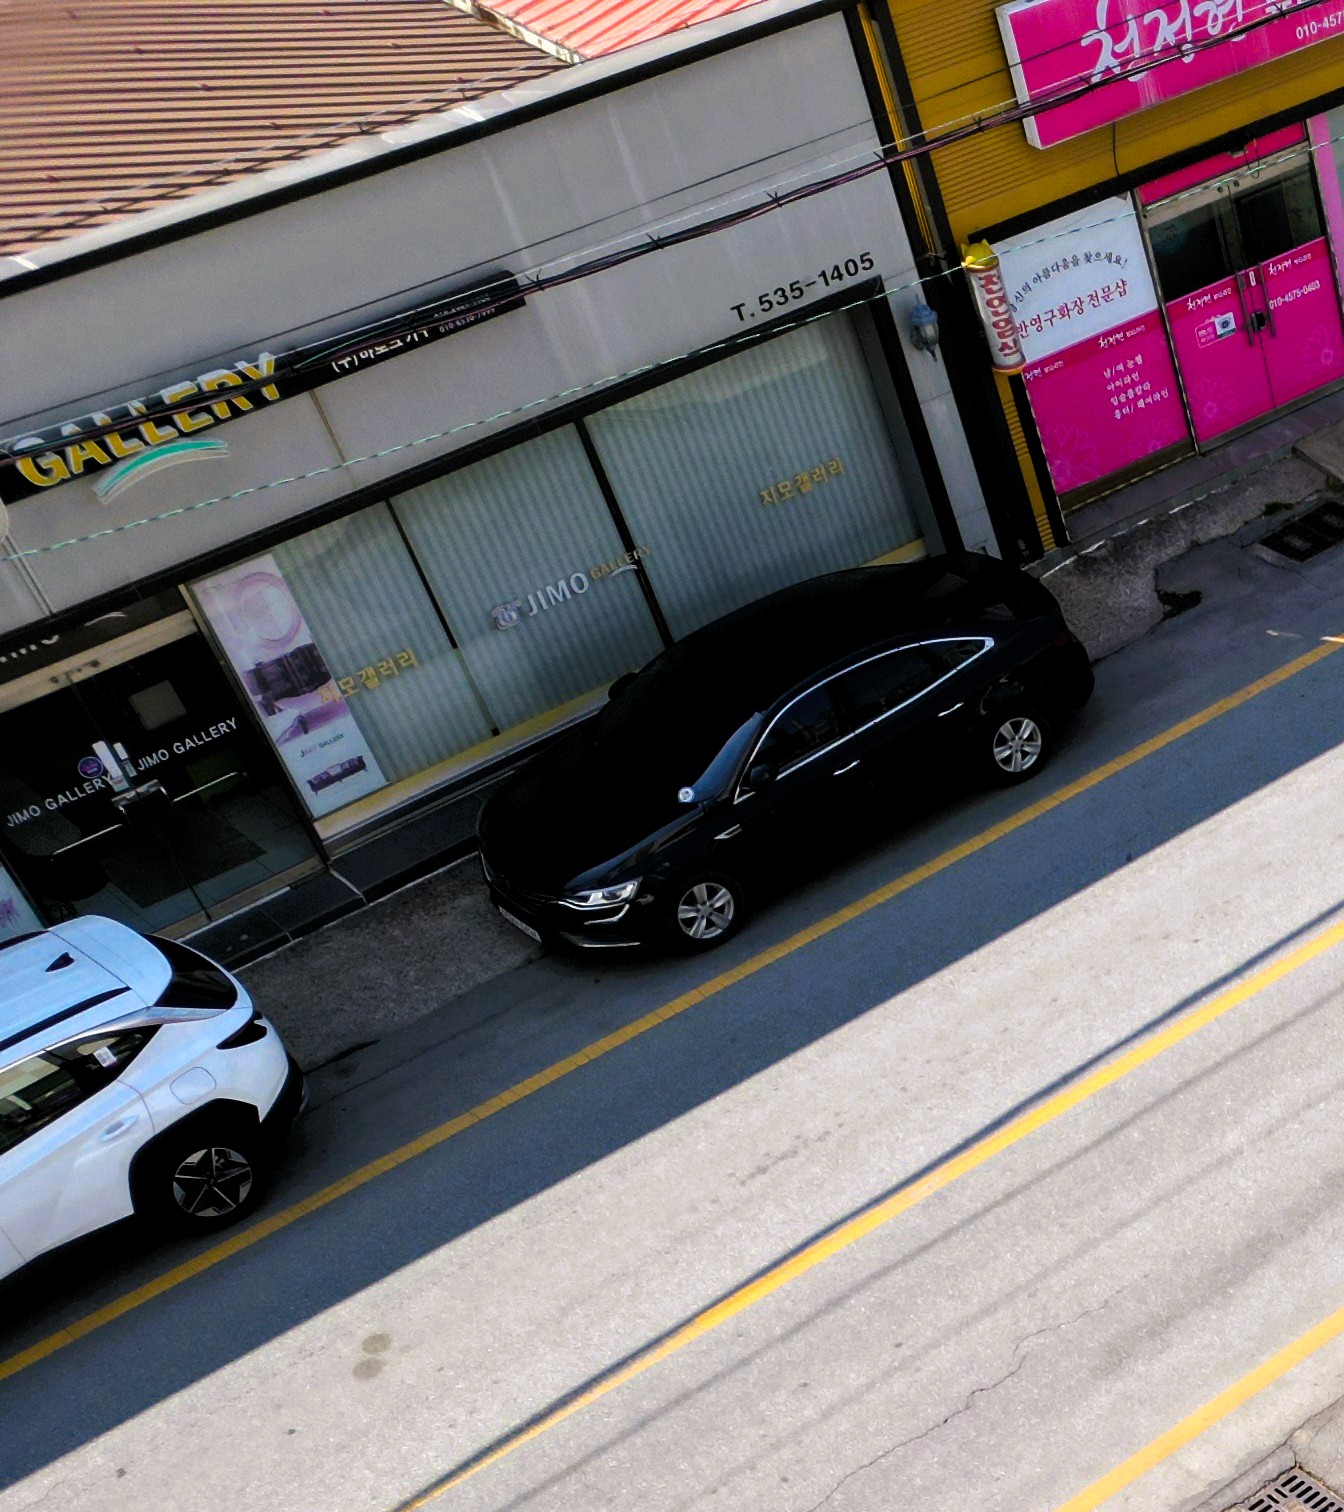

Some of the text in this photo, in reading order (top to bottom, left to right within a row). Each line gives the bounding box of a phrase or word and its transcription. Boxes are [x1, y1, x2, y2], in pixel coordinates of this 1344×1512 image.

[730, 251, 875, 321] T.535-1405
[1087, 278, 1127, 308] 전문샵
[14, 352, 281, 487] GALLERY
[760, 457, 845, 506] 지모갤러리
[527, 571, 590, 616] JIMO
[137, 750, 169, 771] JIMO
[173, 716, 238, 754] GALLERY
[6, 772, 114, 828] JIMO GALLERY
